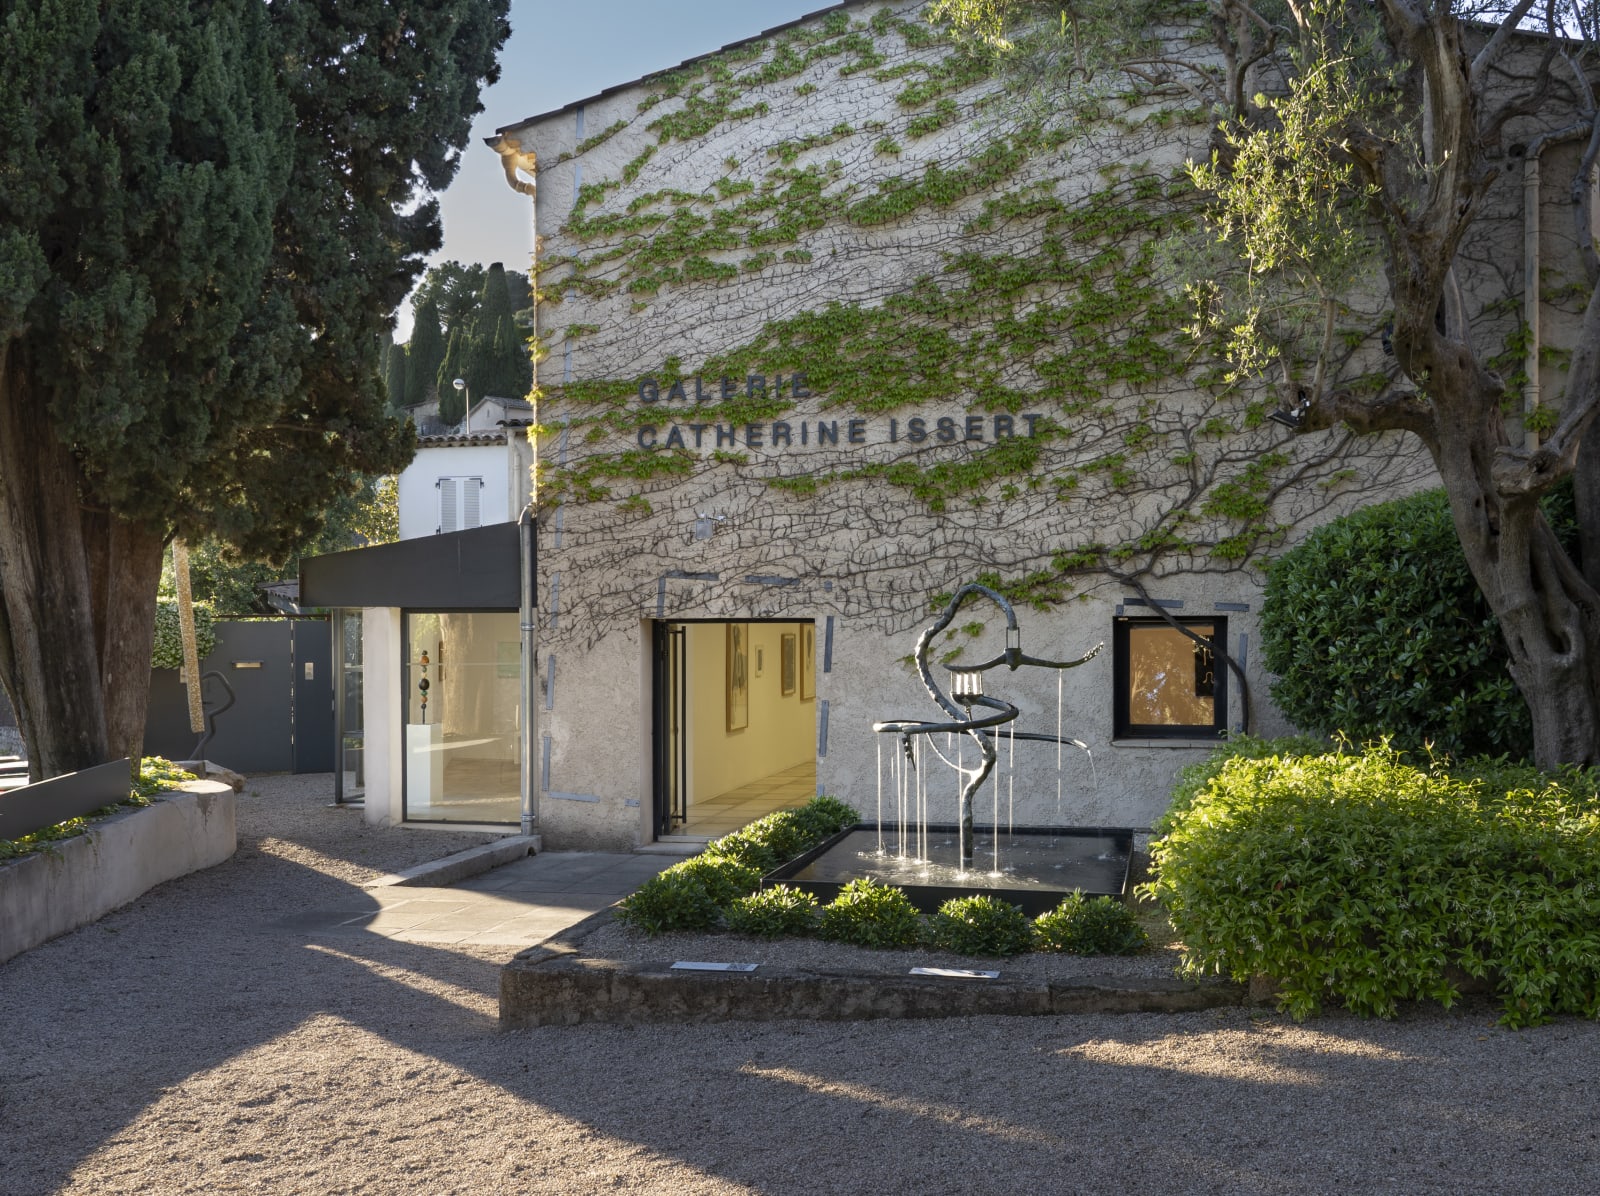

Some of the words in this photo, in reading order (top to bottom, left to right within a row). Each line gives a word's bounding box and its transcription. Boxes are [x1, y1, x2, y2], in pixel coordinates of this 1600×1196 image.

[638, 373, 809, 402] GALERIE
[637, 420, 867, 450] CATHERINE
[890, 413, 1042, 443] ISSERT
